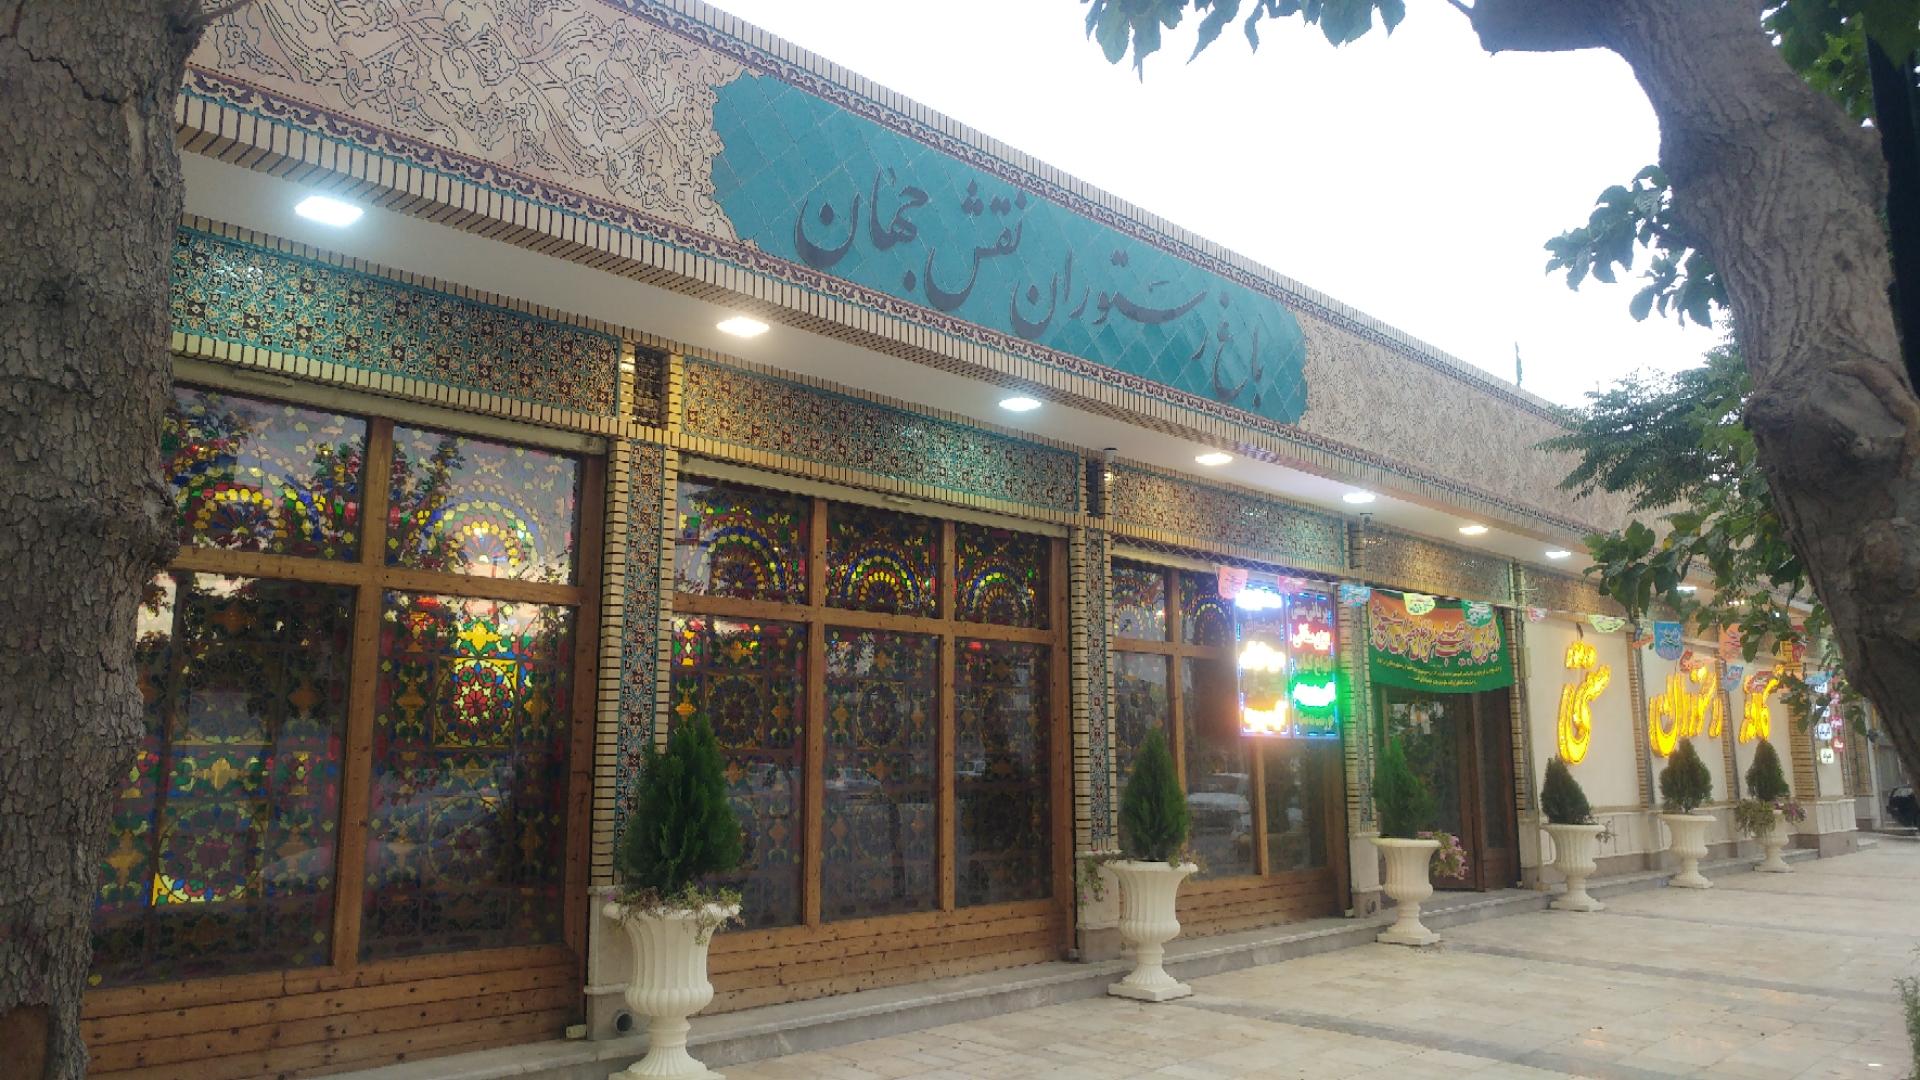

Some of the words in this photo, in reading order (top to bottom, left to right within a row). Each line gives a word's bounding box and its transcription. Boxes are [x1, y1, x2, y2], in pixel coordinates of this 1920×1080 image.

[794, 166, 929, 293] جهان
[923, 178, 1027, 313] نقش
[1010, 246, 1209, 361] رستوران
[1212, 291, 1264, 408] باغ
